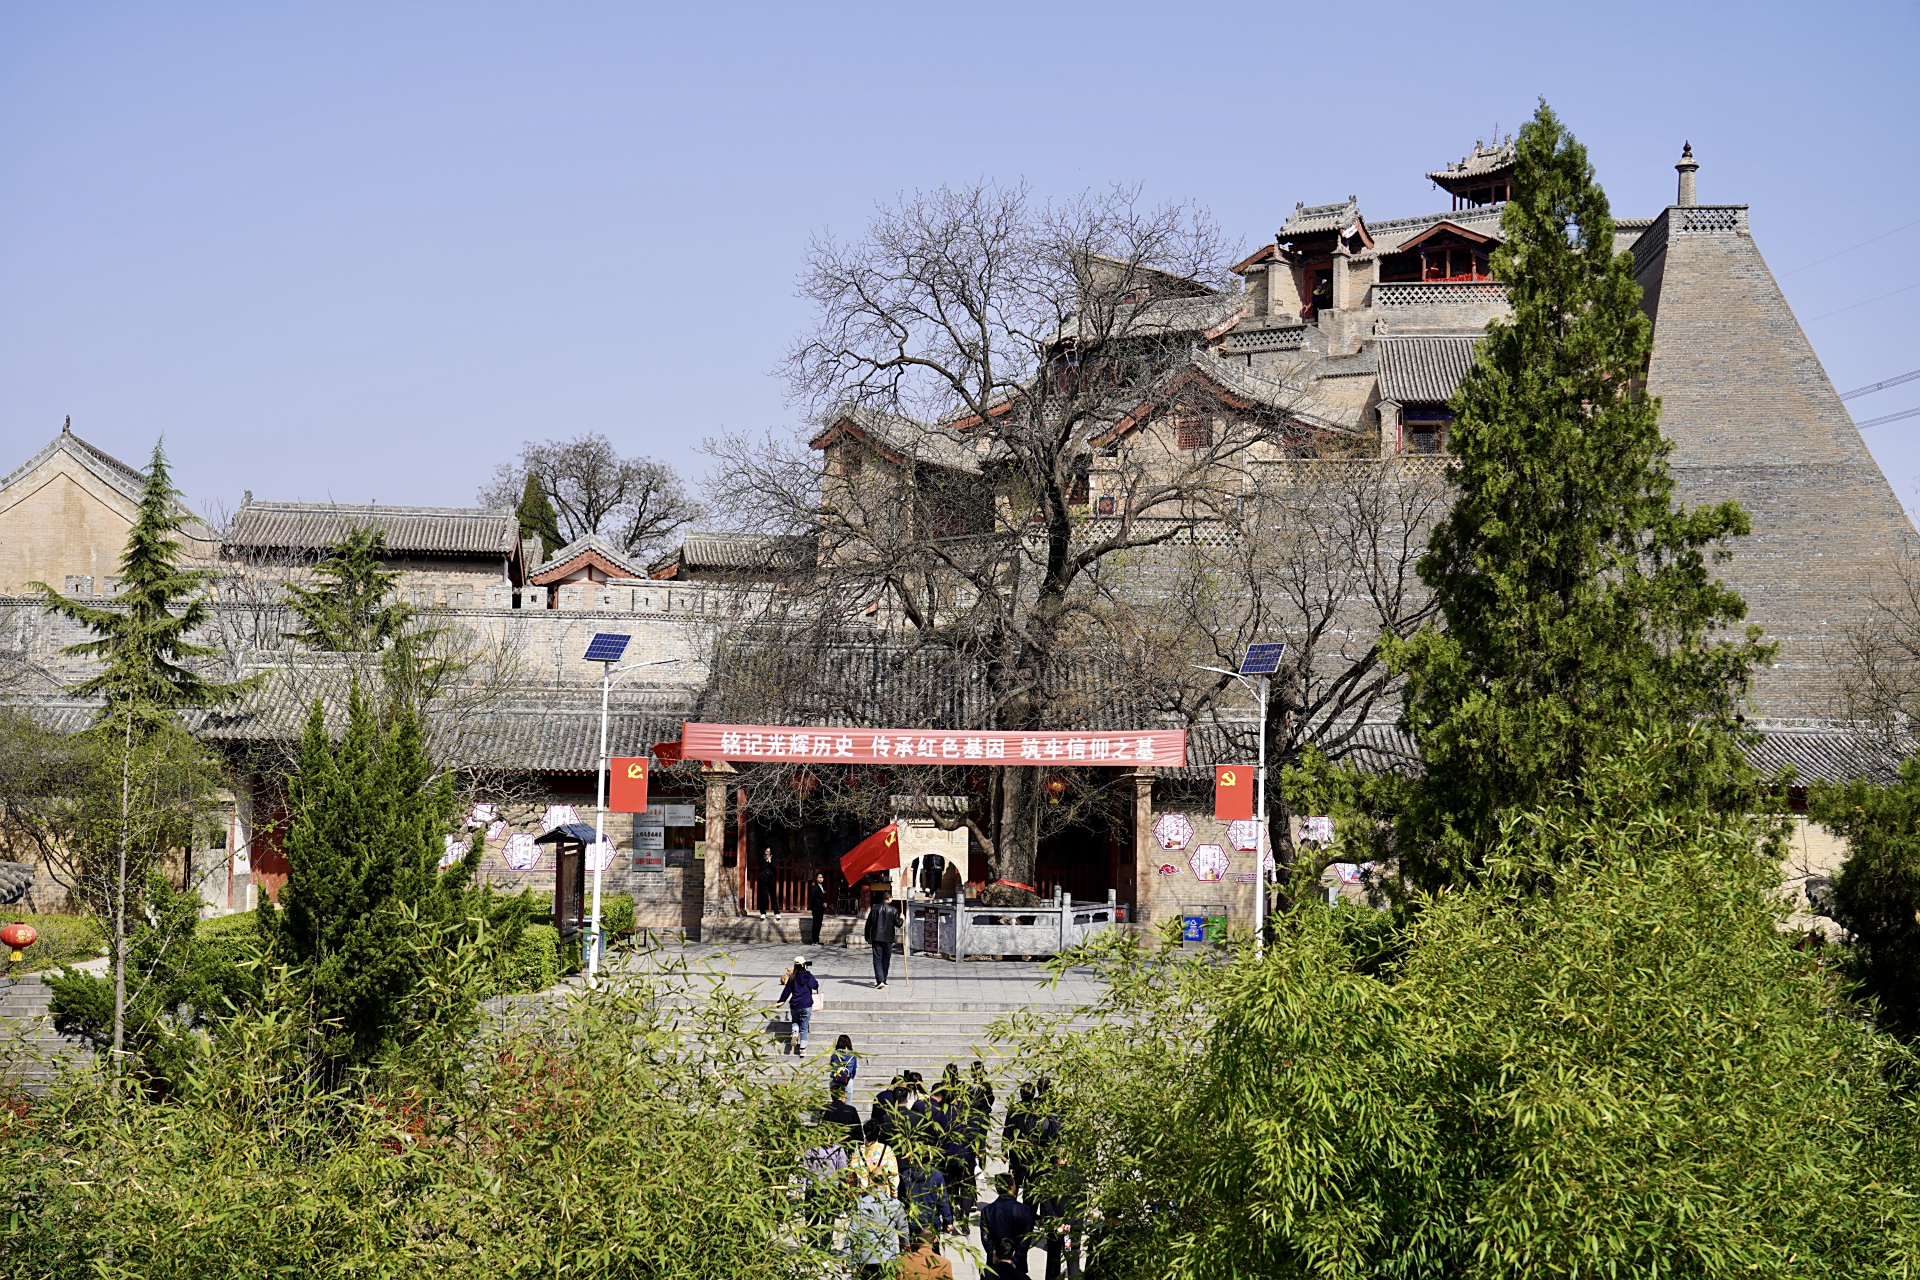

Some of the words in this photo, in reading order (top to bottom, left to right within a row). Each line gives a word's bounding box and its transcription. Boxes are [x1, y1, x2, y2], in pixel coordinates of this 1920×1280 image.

[721, 731, 854, 757] 铭记光辉历史
[870, 735, 1005, 758] 传承红色基因
[1020, 737, 1156, 760] 筑牢信仰之基
